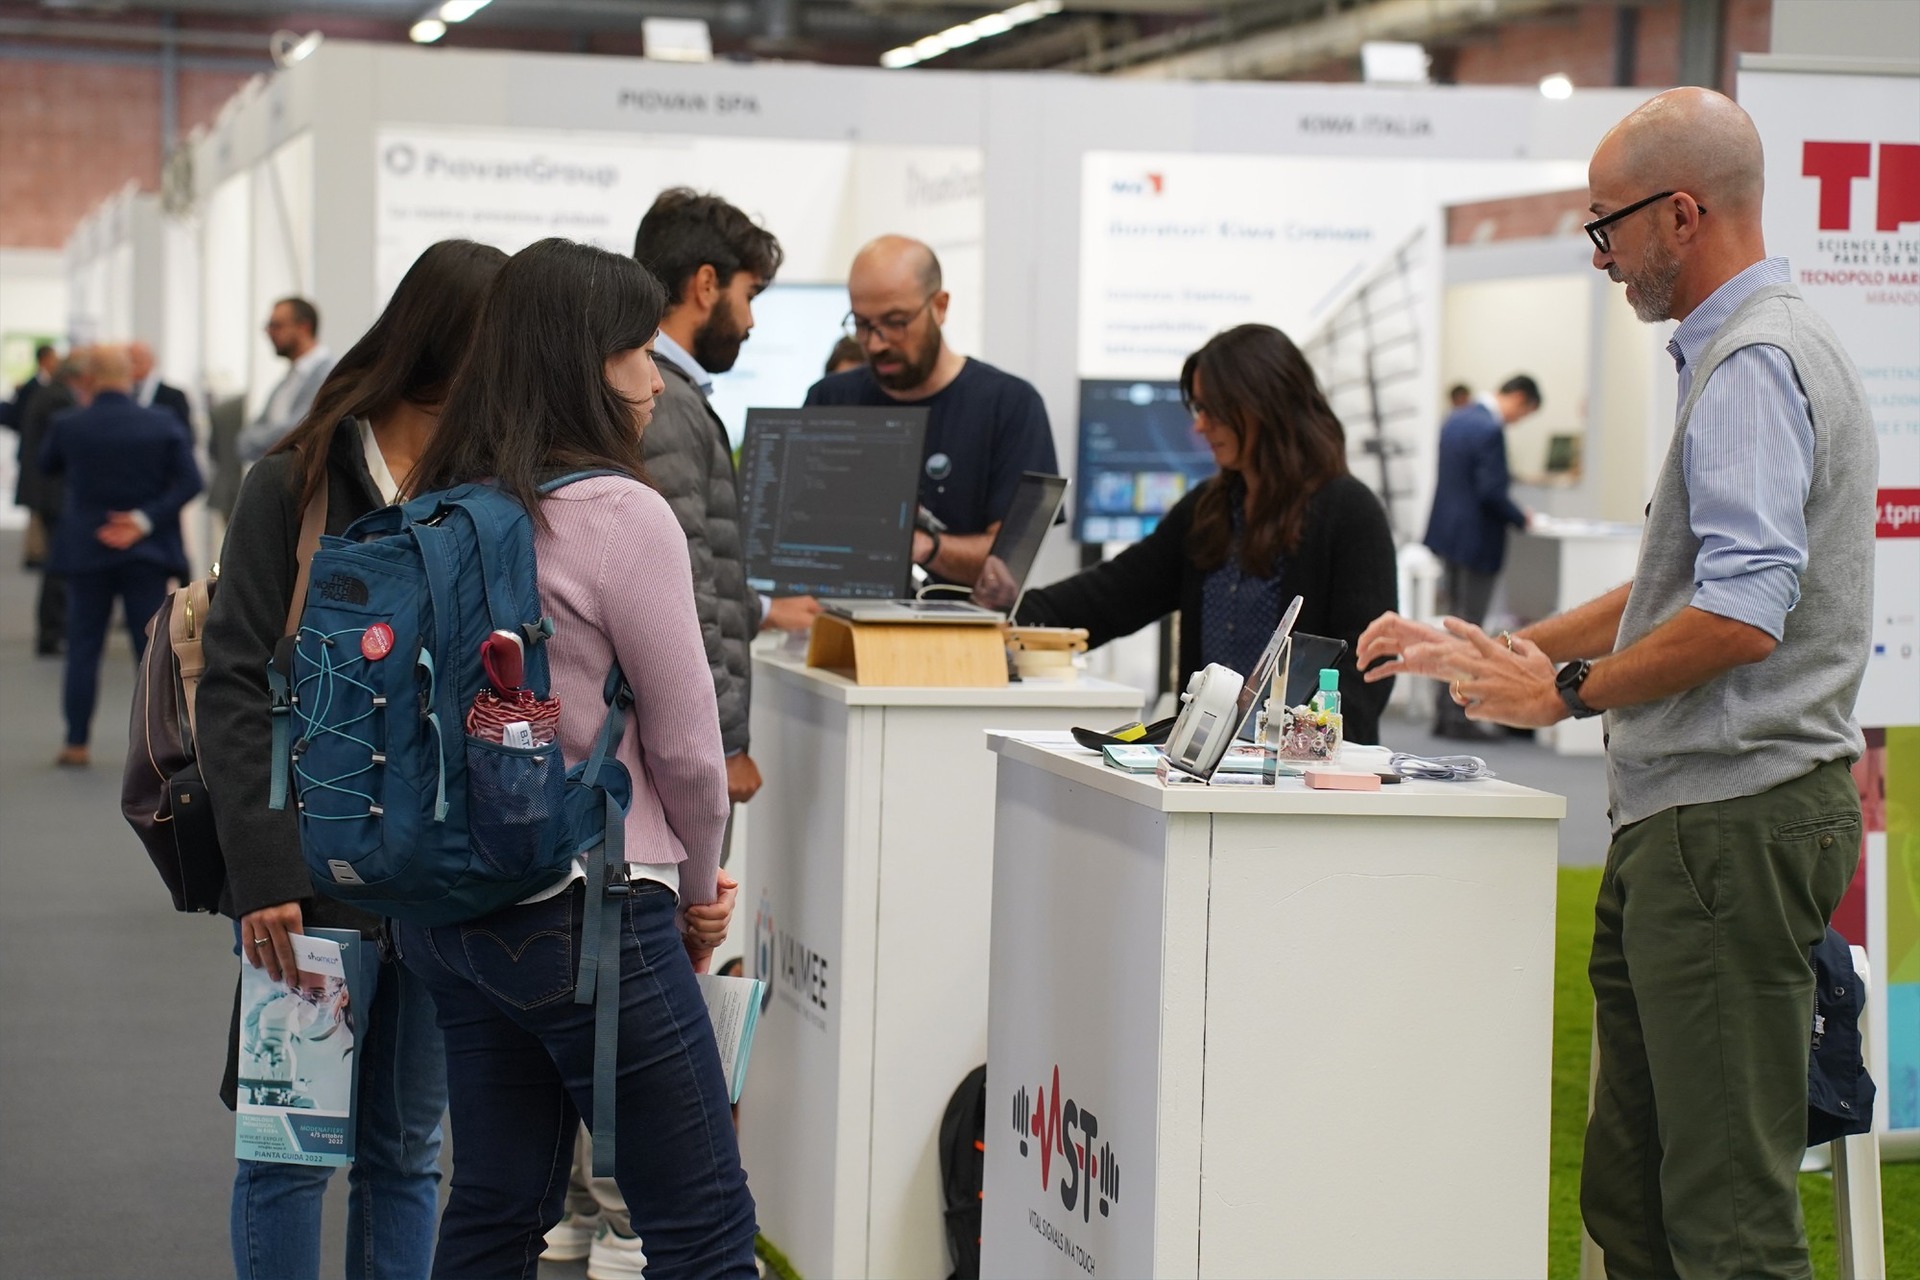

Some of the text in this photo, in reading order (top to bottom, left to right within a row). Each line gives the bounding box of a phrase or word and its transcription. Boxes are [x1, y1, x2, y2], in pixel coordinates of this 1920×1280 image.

[1818, 240, 1876, 252] SCIENCE
[1834, 254, 1868, 265] PARK
[1800, 270, 1884, 287] TECNOPOLO
[330, 573, 352, 585] THE
[314, 580, 351, 594] NORTH
[321, 590, 349, 602] FACE
[300, 1125, 344, 1134] MODENAFIERE
[254, 1150, 323, 1162] PIANTA GUIDA 2022
[1028, 1207, 1042, 1235] VITAL
[1042, 1218, 1064, 1251] SIGNALS
[1064, 1236, 1071, 1257] IN
[1076, 1244, 1096, 1277] TOUCH
